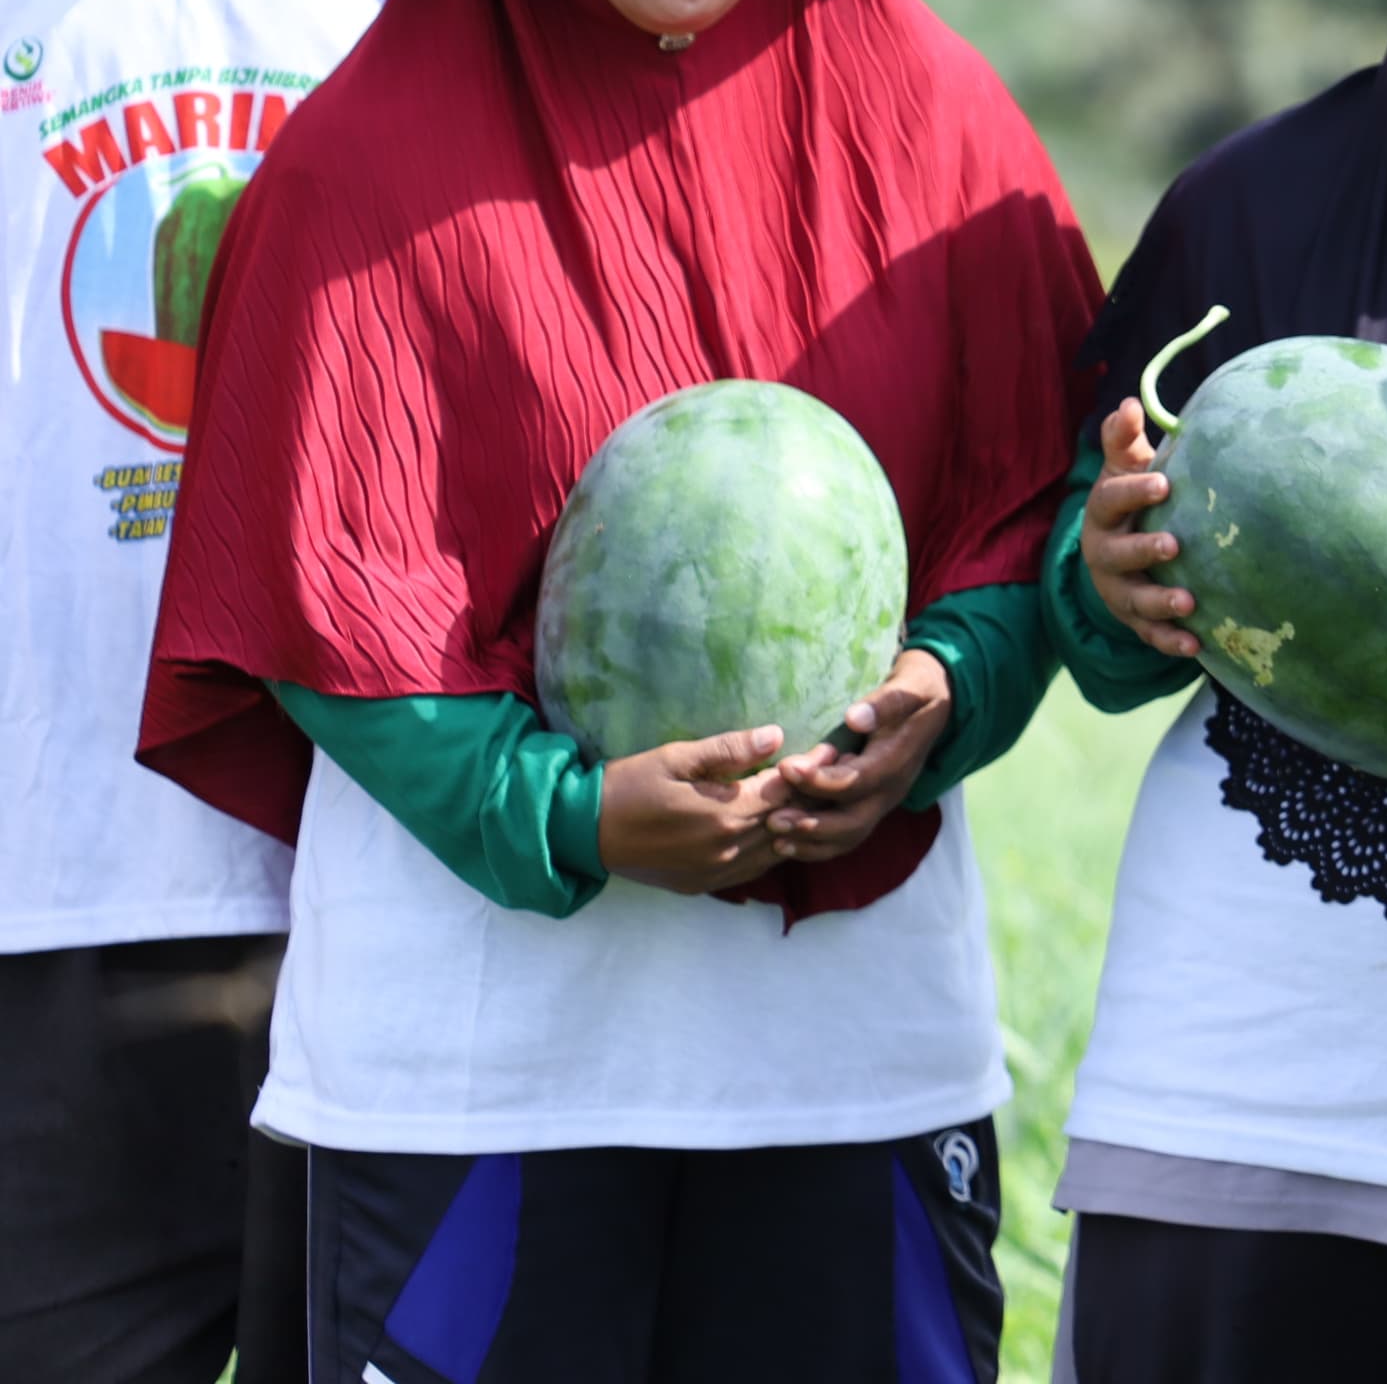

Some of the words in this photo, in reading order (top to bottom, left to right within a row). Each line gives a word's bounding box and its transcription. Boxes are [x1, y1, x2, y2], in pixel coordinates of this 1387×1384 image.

[39, 76, 144, 141] SEMANGKA
[151, 67, 212, 91] TANPA
[218, 67, 259, 86] BIJI
